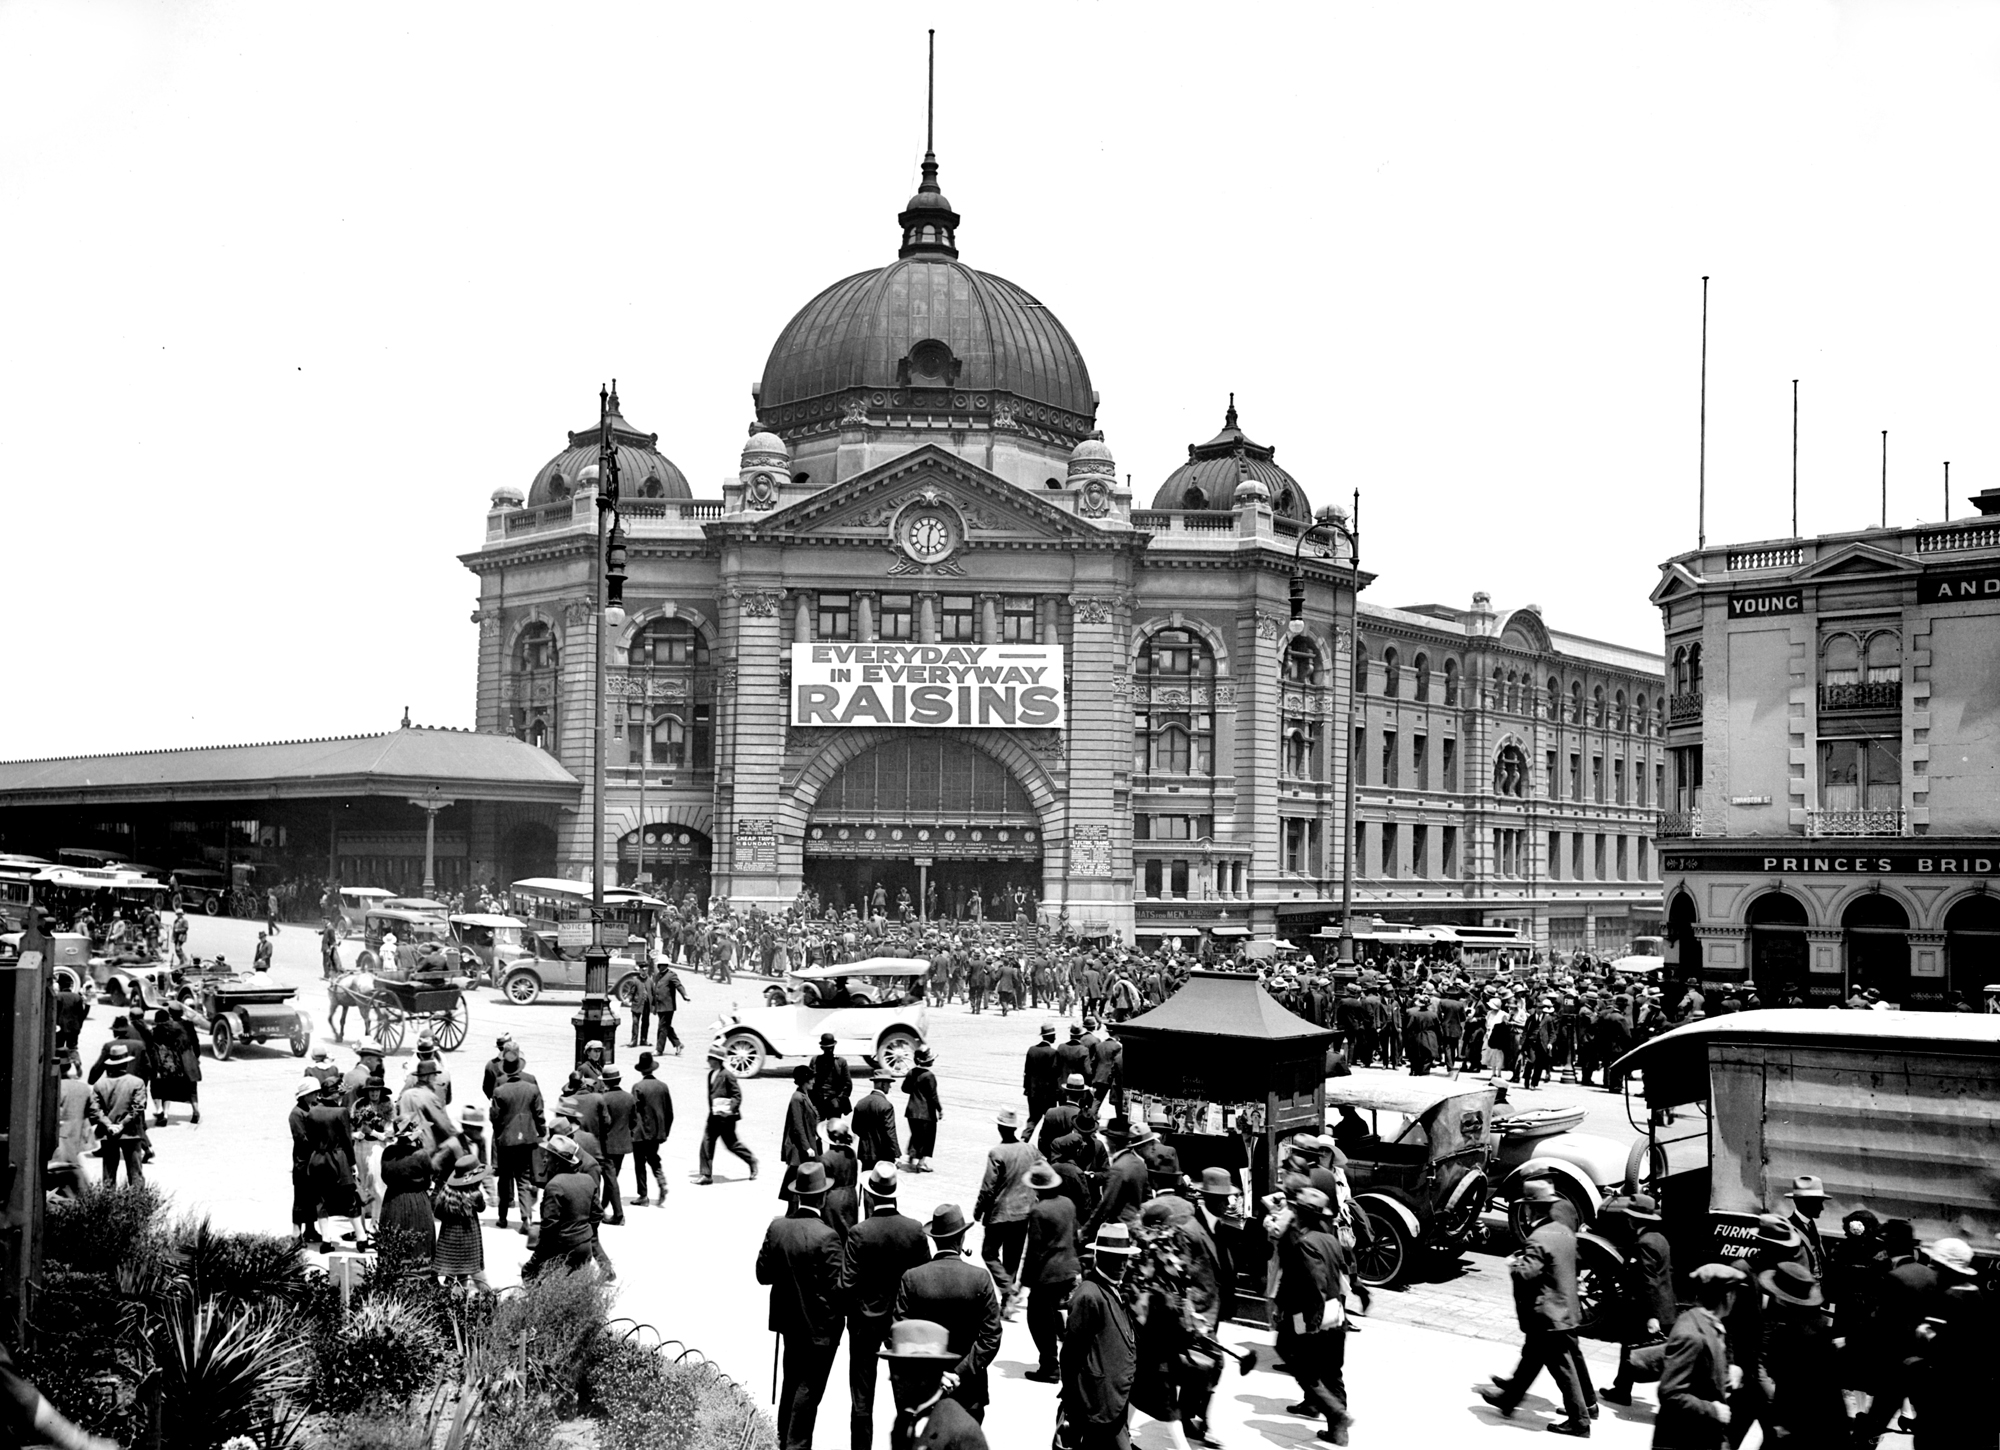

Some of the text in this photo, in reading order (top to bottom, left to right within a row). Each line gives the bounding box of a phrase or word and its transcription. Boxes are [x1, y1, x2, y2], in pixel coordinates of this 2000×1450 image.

[1733, 595, 1798, 613] YOUNG
[812, 645, 988, 664] EVERYDAY
[830, 665, 1048, 684] IN EVERYWAY
[797, 685, 1060, 725] RAISINS
[1732, 796, 1762, 804] SWANSTON
[1764, 858, 1892, 871] PRINCE'S
[1136, 910, 1155, 919] HATS
[1167, 911, 1185, 919] MEN
